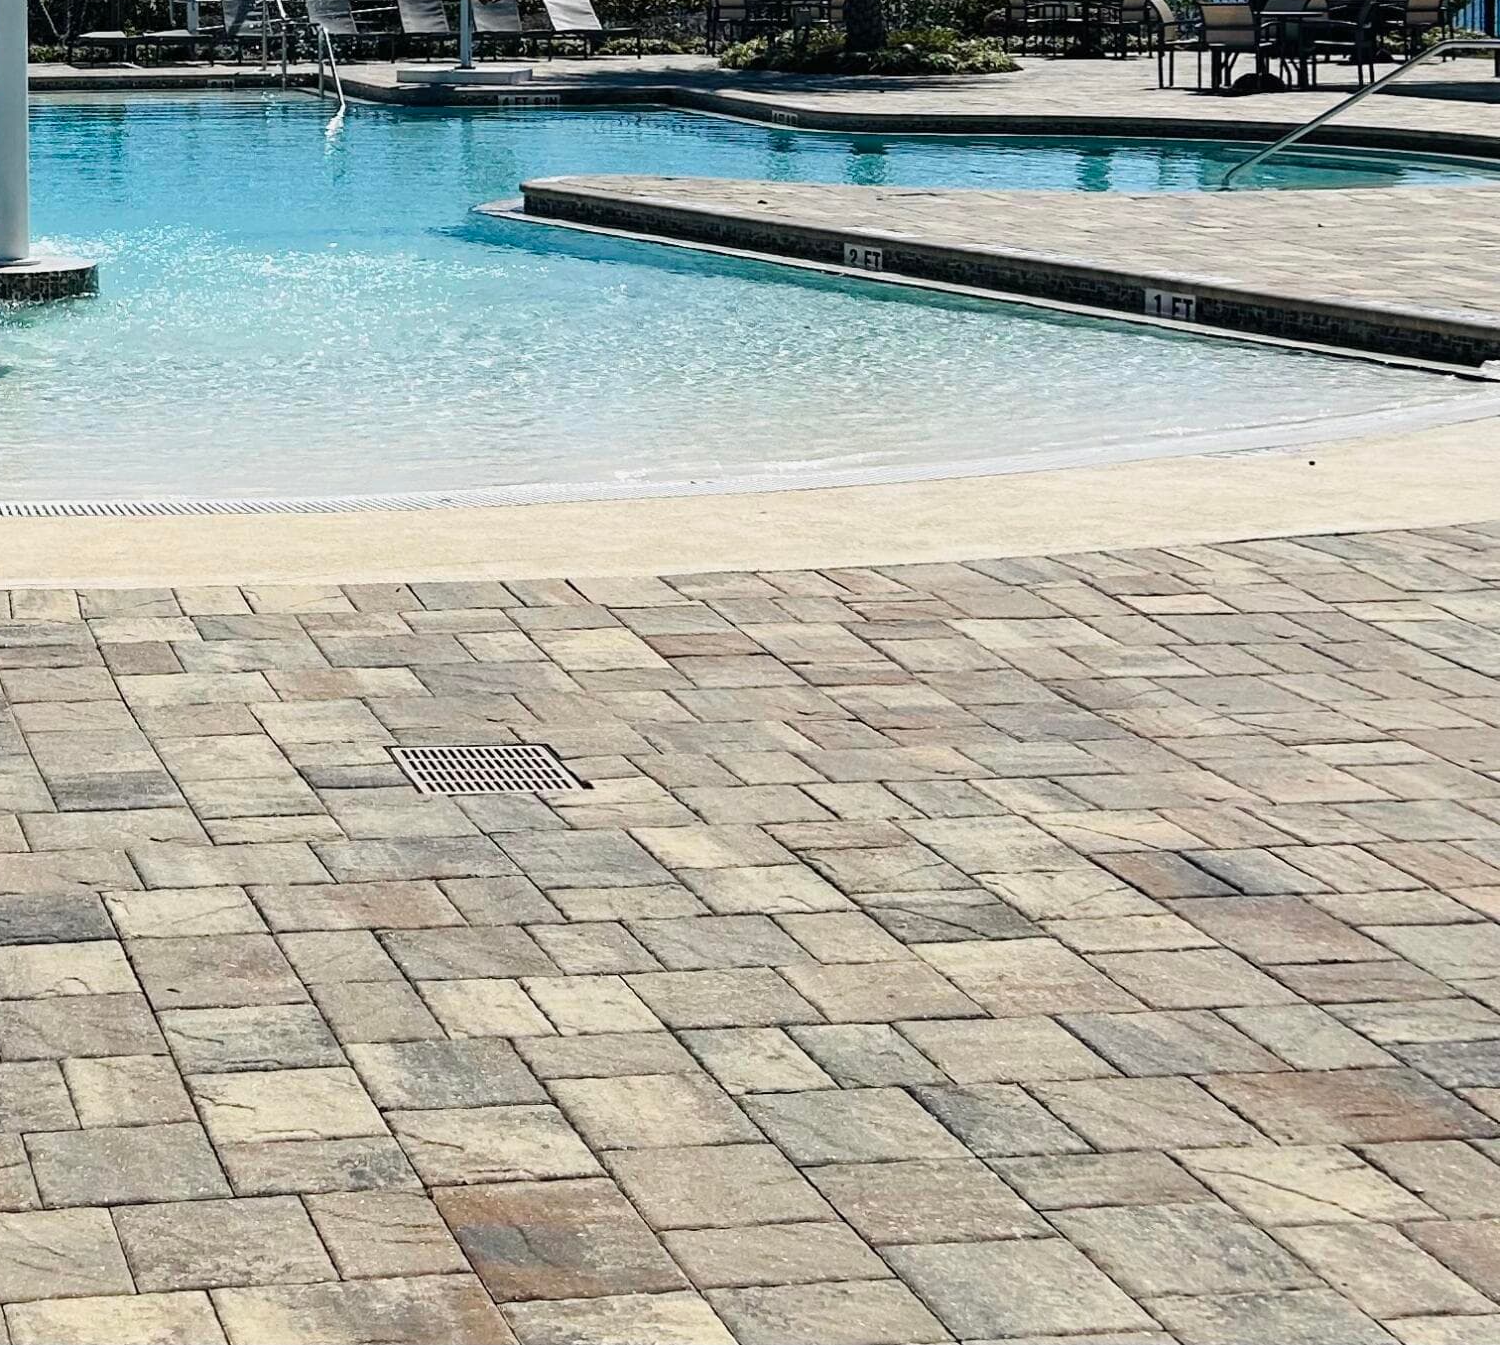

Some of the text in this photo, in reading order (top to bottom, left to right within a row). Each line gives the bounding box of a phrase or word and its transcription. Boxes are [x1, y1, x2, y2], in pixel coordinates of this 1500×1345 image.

[850, 249, 881, 267] 2 FT
[1154, 294, 1193, 318] 1 FT
